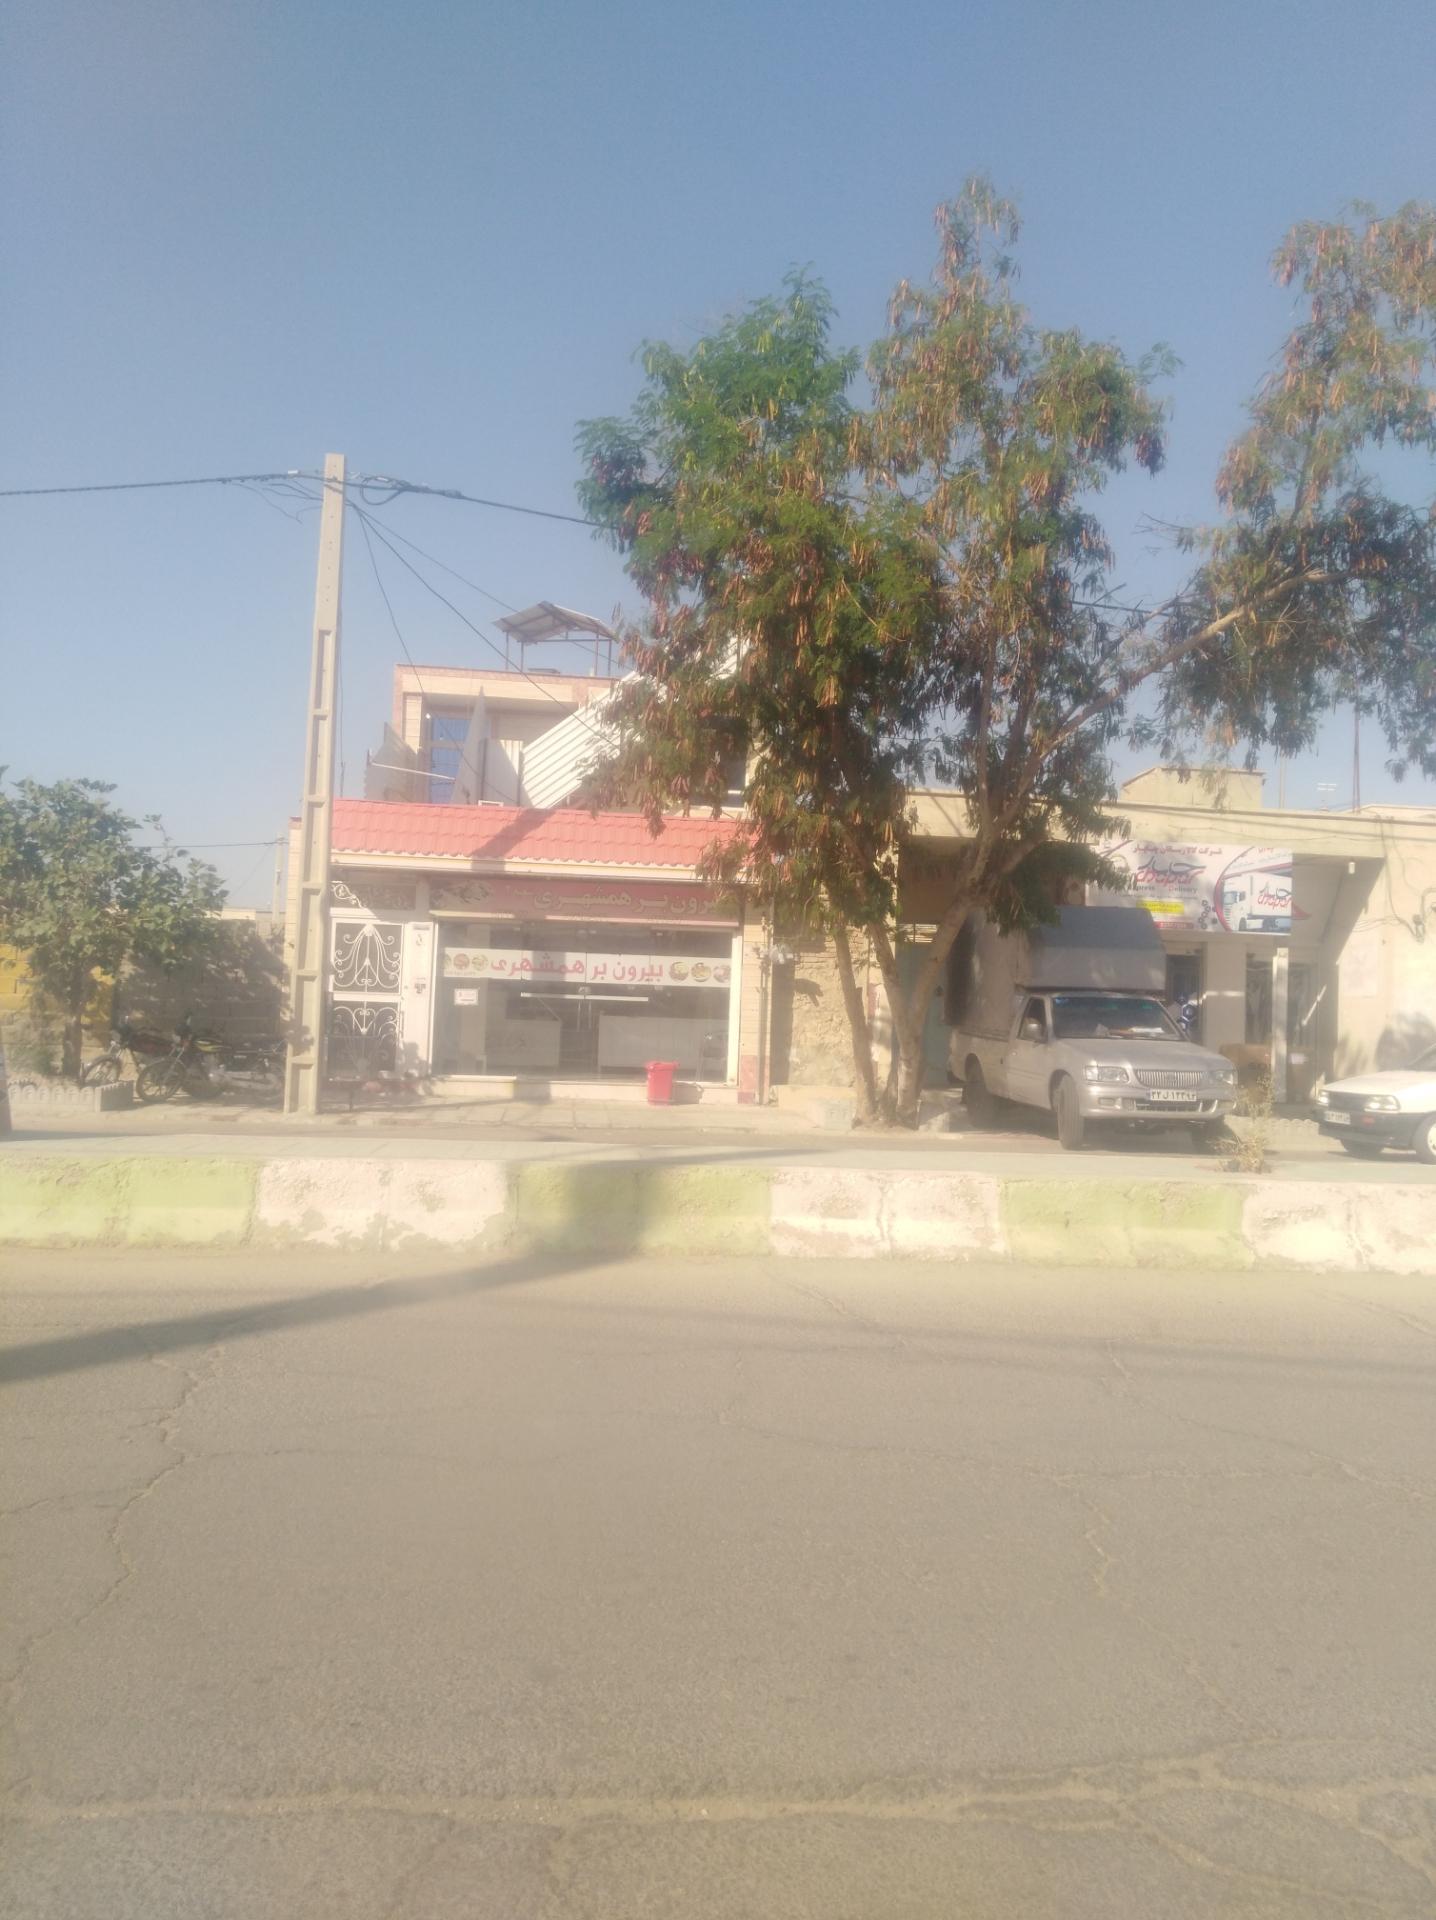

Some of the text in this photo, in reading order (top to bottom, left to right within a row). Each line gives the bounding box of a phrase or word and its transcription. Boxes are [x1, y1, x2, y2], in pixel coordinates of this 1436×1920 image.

[490, 954, 663, 981] بیرون بر همشهری
